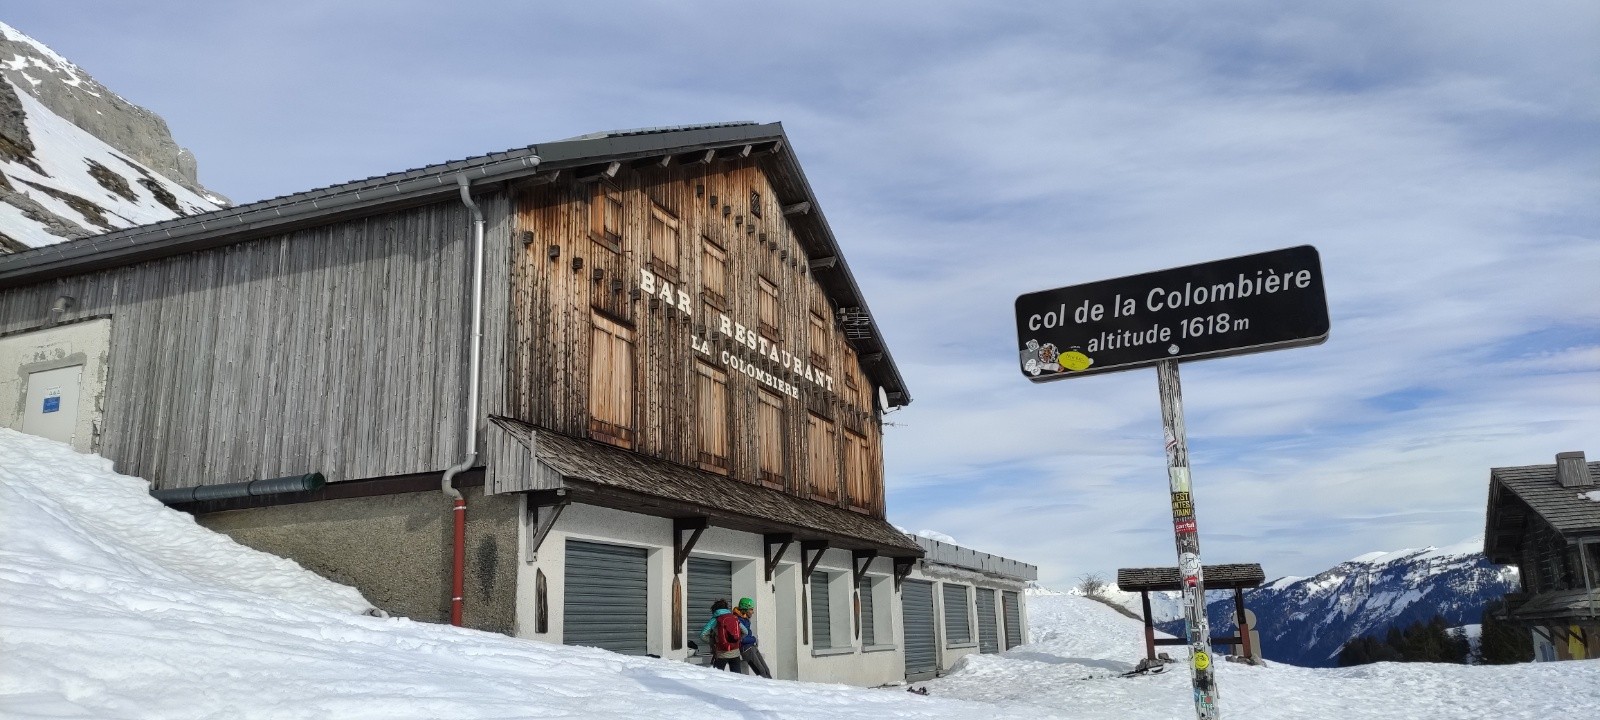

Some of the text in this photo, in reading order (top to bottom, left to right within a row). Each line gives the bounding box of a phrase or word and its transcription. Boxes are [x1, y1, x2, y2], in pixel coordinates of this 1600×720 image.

[640, 268, 833, 392] BAR RESTAURANT
[1028, 268, 1311, 331] col de la Colombière
[1087, 313, 1250, 353] altitude 1618 m
[691, 335, 799, 400] LA COLOMBIERE
